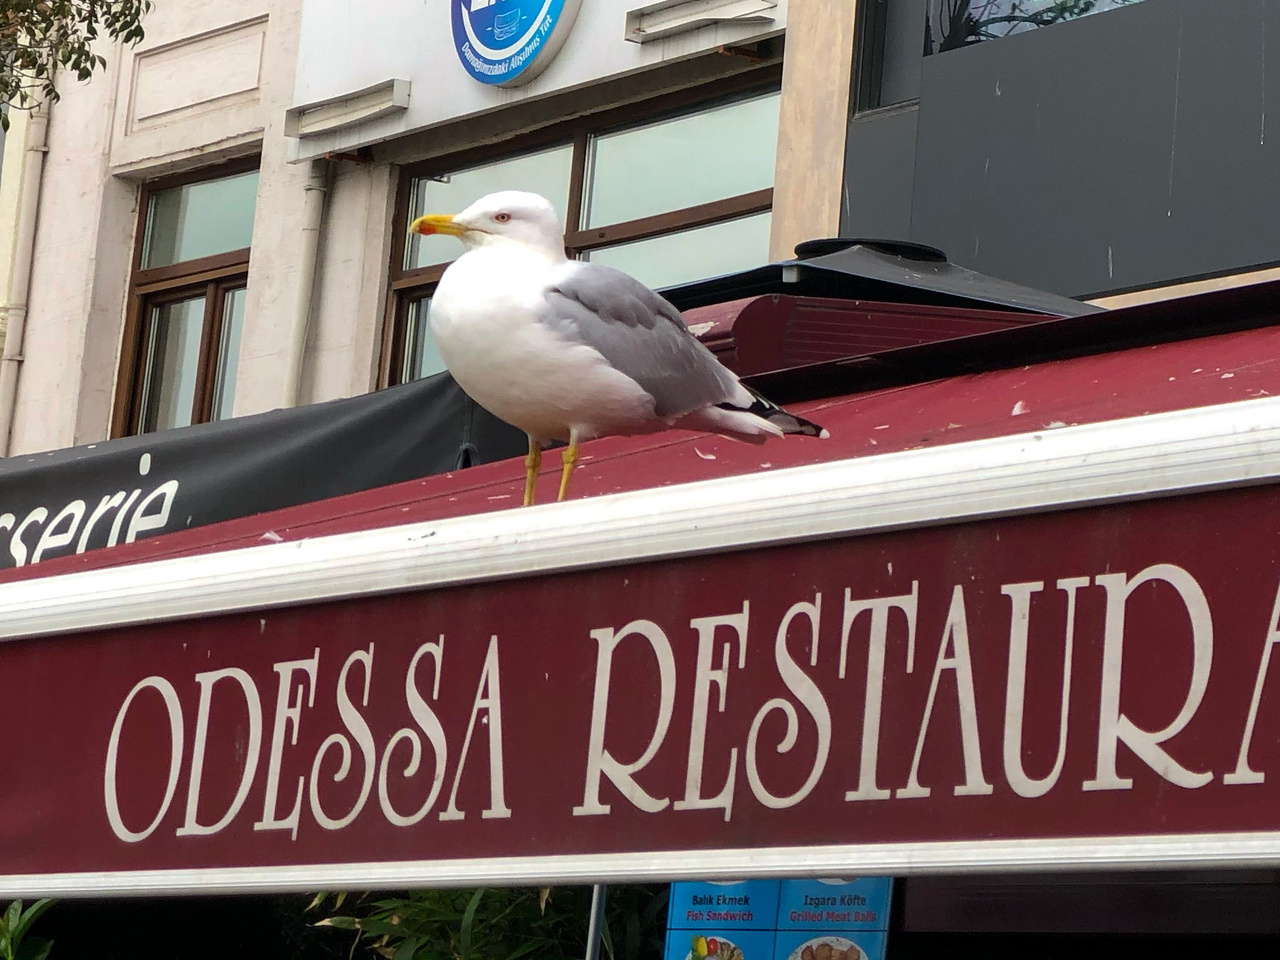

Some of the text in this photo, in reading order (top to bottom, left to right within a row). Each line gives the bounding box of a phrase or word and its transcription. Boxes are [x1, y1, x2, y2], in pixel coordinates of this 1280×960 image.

[539, 14, 554, 36] Tat
[104, 632, 512, 843] ODESSA
[716, 895, 750, 906] Ekmek
[840, 894, 867, 906] Köfte
[686, 910, 754, 922] Fish Sandwich
[789, 911, 877, 923] Grilled Meat Balls
